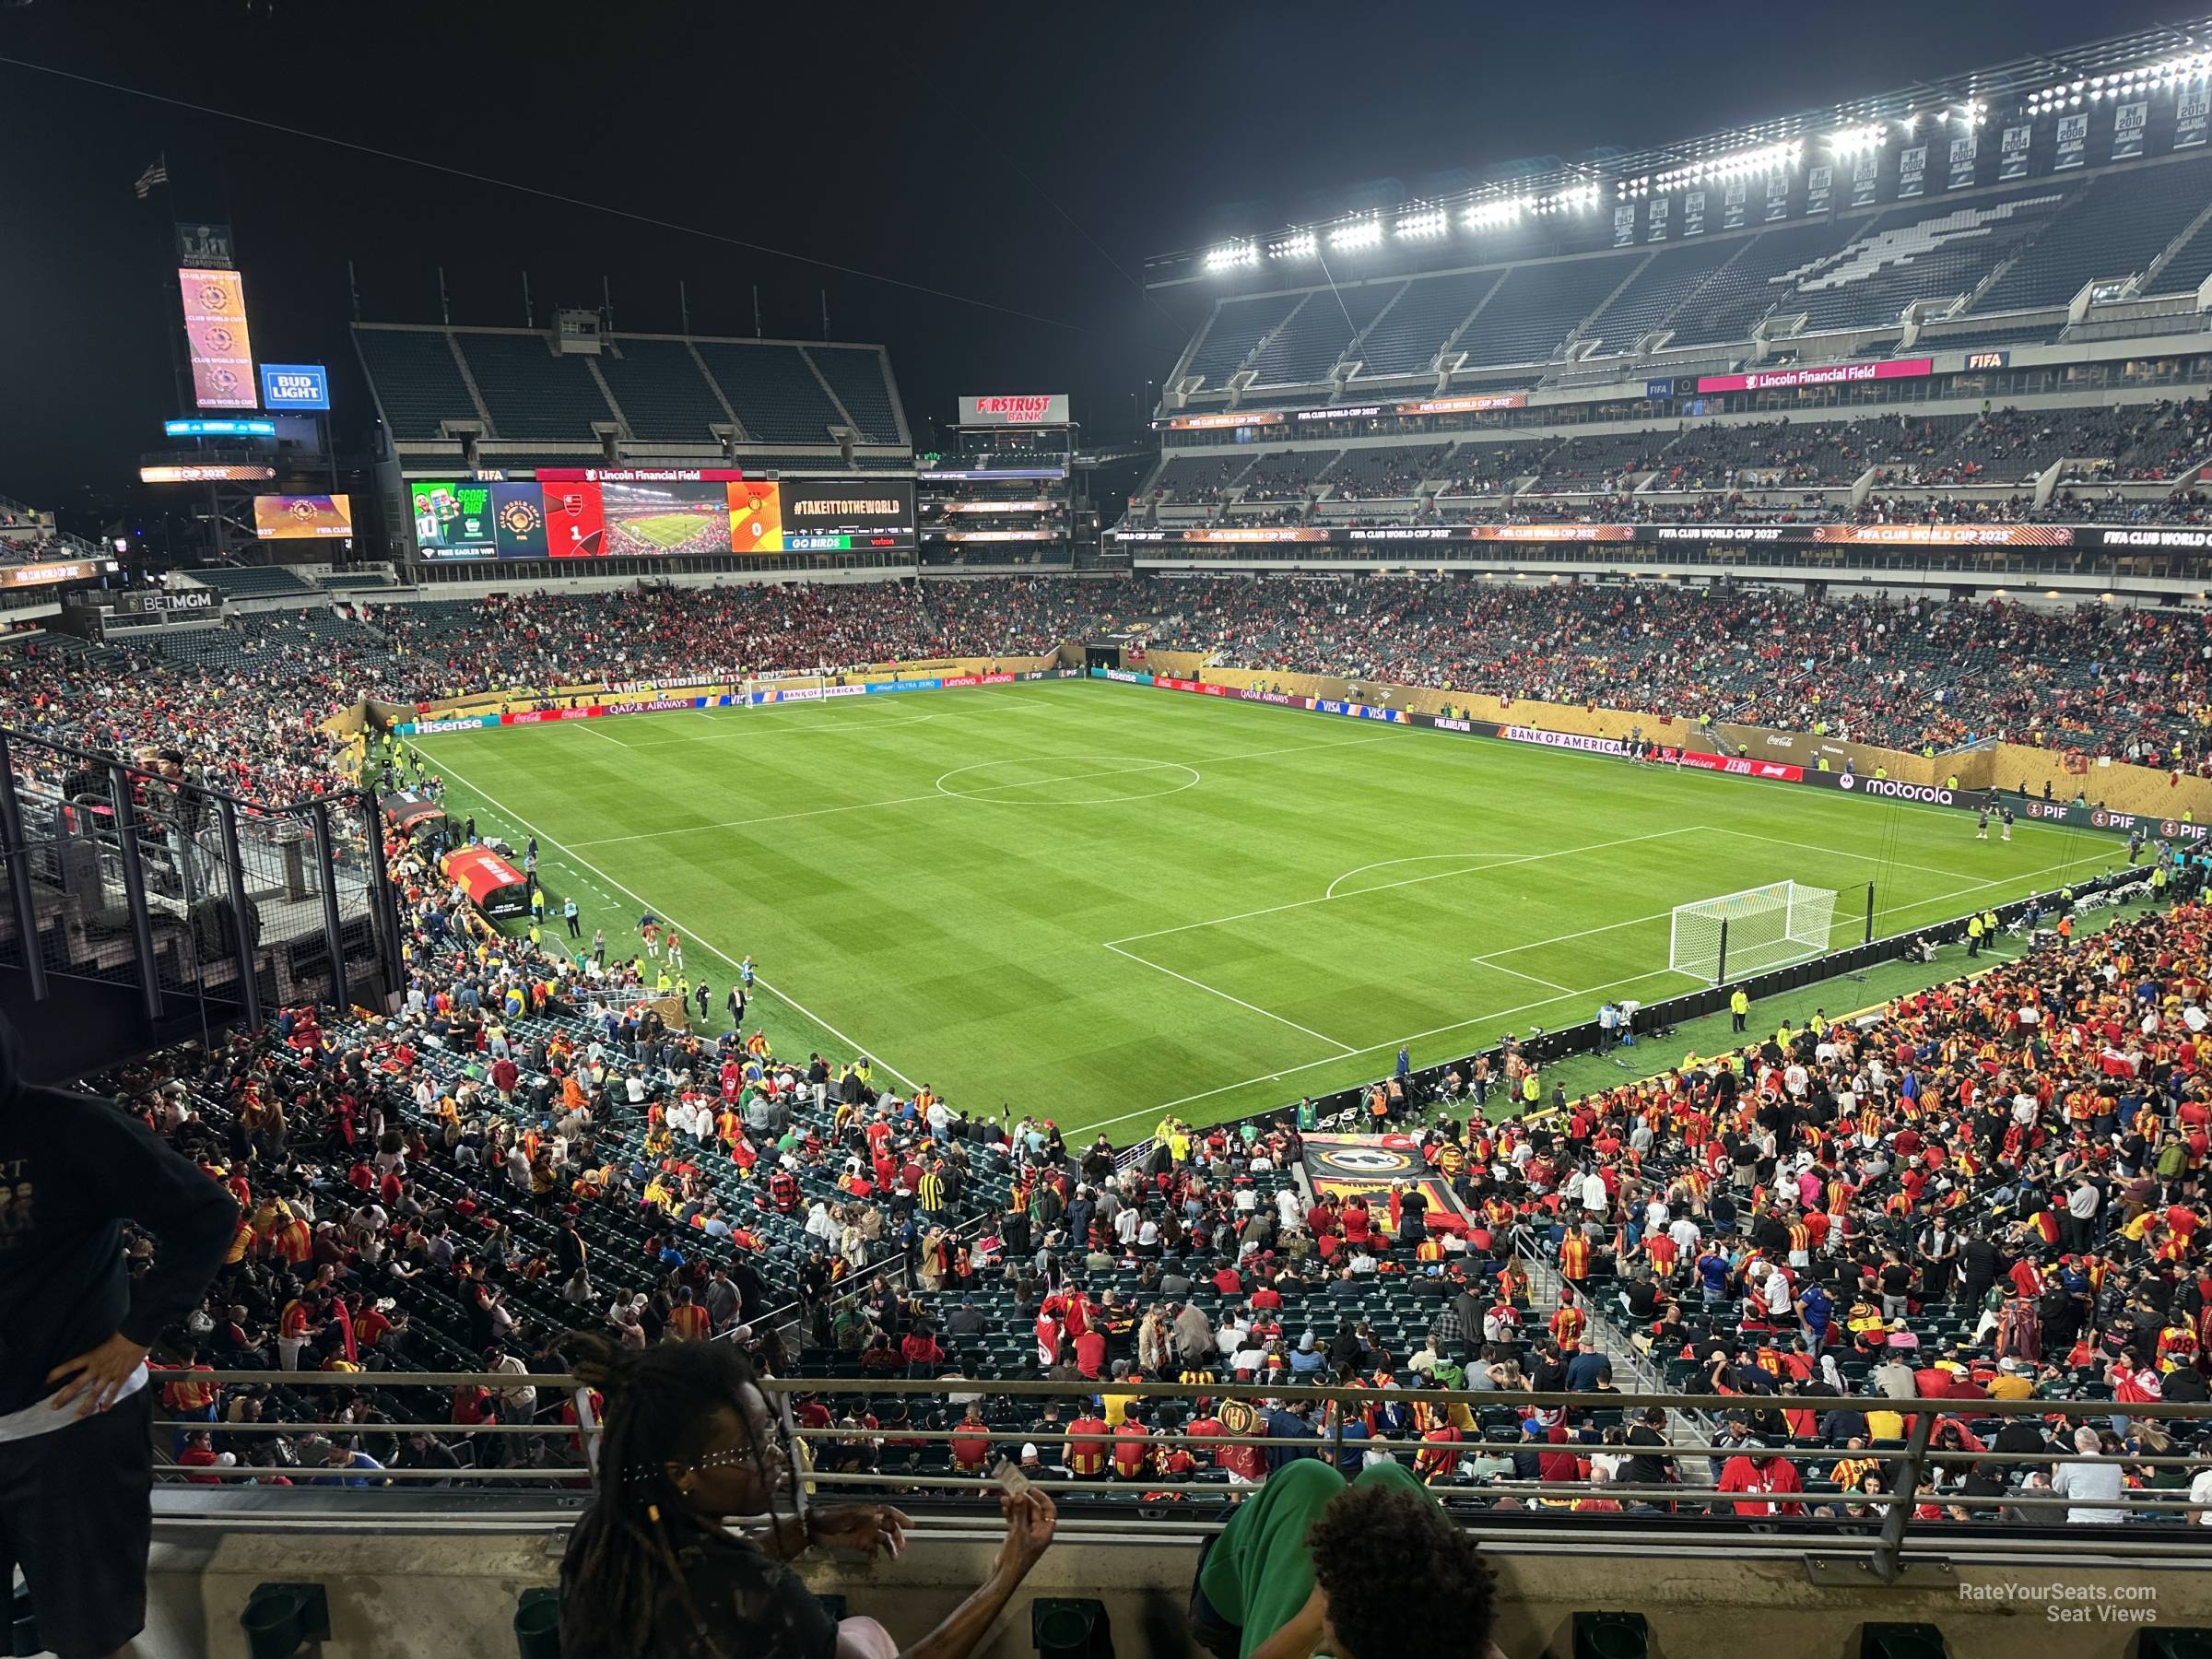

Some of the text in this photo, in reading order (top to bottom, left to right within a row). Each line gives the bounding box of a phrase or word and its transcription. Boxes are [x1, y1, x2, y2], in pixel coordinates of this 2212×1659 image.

[2181, 104, 2206, 116] 2013
[2120, 115, 2142, 126] 2010
[2060, 127, 2084, 138] 2006
[2005, 138, 2027, 149] 2004
[1953, 149, 1974, 160] 2003
[1903, 159, 1923, 171] 2002
[1856, 170, 1875, 179] 2001
[1970, 354, 2002, 368] FIFA
[278, 376, 311, 387] BUD
[1760, 366, 1875, 386] Lincoln Financial Field
[273, 387, 318, 398] LIGHT
[1650, 385, 1666, 394] FIFA
[1453, 401, 1476, 409] WORLD
[1007, 412, 1042, 422] BANK
[1298, 412, 1311, 420] FIFA
[1327, 409, 1348, 418] WORLD
[1349, 408, 1361, 417] CUP
[477, 470, 503, 481] FIFA
[599, 470, 700, 480] Lincoln Financial Field
[457, 489, 488, 502] SCORE
[464, 501, 483, 514] BIG!
[503, 500, 527, 511] WORLD
[794, 500, 900, 514] #TAKEITTOTHEWORLD
[571, 525, 582, 540] 1
[751, 523, 762, 536] 0
[1387, 530, 1410, 538] WORLD
[1659, 529, 1753, 538] FIFA CLUB WORLD CUP
[1857, 531, 1978, 540] FIFA CLUB WORLD CUP
[792, 535, 841, 548] GO BIRDS
[870, 538, 894, 547] verizon
[2103, 531, 2128, 544] FIFA
[2129, 531, 2160, 545] CLUB
[2160, 532, 2206, 546] WORLD
[437, 548, 453, 557] FREE
[144, 594, 212, 611] BETMGM
[982, 675, 1012, 683] Lenovo
[1107, 670, 1136, 682] Hisense
[945, 678, 976, 687] Lenovo
[1241, 690, 1288, 704] QATAR AIRWAYS
[610, 700, 688, 714] QATAR AIRWAYS
[1323, 701, 1340, 713] VISA
[513, 712, 542, 723] Coca-Cola
[560, 709, 588, 719] Coca-Cola
[1367, 707, 1386, 721] VISA
[415, 719, 482, 734] Hisense
[1435, 718, 1470, 731] PHILADELPHIA
[1511, 728, 1620, 754] BANK OF AMERICA
[1767, 735, 1794, 747] Coca-Cola
[1822, 745, 1843, 754] Hisense
[1724, 759, 1751, 774] ZERO
[1866, 780, 1953, 805] motorola
[2044, 806, 2068, 818] PIF
[2110, 815, 2136, 829] PIF
[2180, 824, 2206, 839] PIF
[2172, 1337, 2193, 1354] 28
[1760, 1358, 1778, 1375] 19
